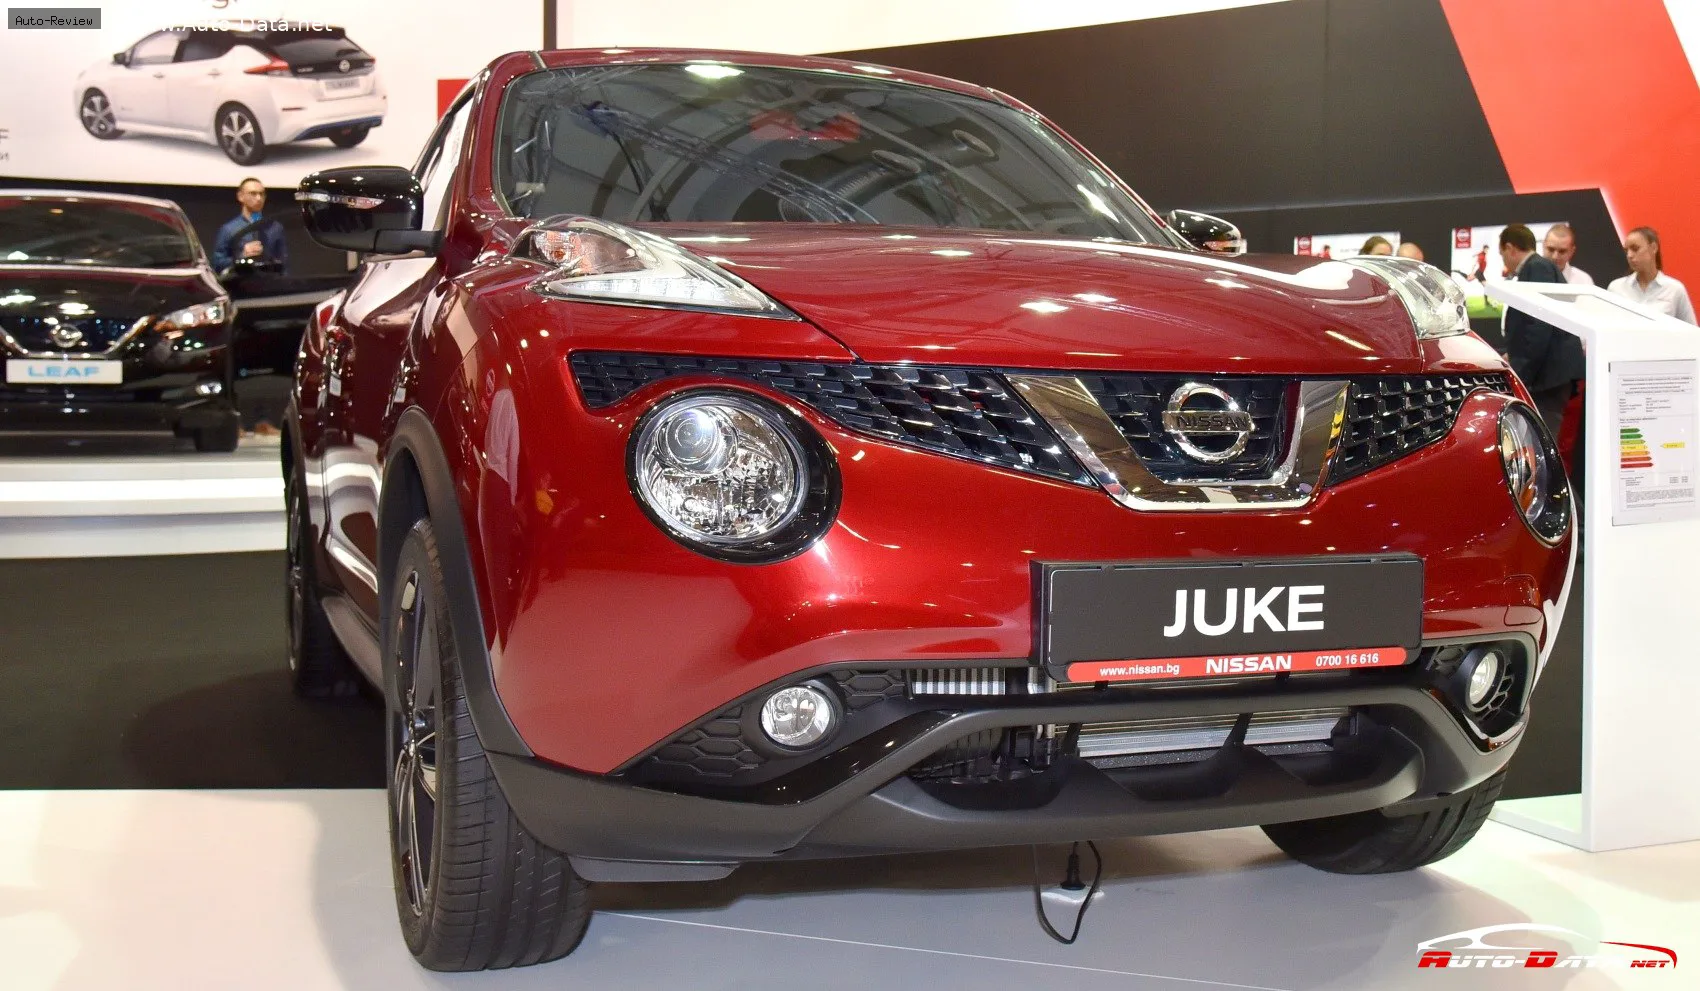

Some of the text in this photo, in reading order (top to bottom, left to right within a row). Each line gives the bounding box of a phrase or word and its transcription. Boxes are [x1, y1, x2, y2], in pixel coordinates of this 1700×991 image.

[27, 365, 100, 378] LEAF
[1177, 415, 1247, 429] NISSAN
[1163, 584, 1325, 638] JUKE
[1099, 652, 1379, 678] www.nissan.bg NISSAN 0700 16 616
